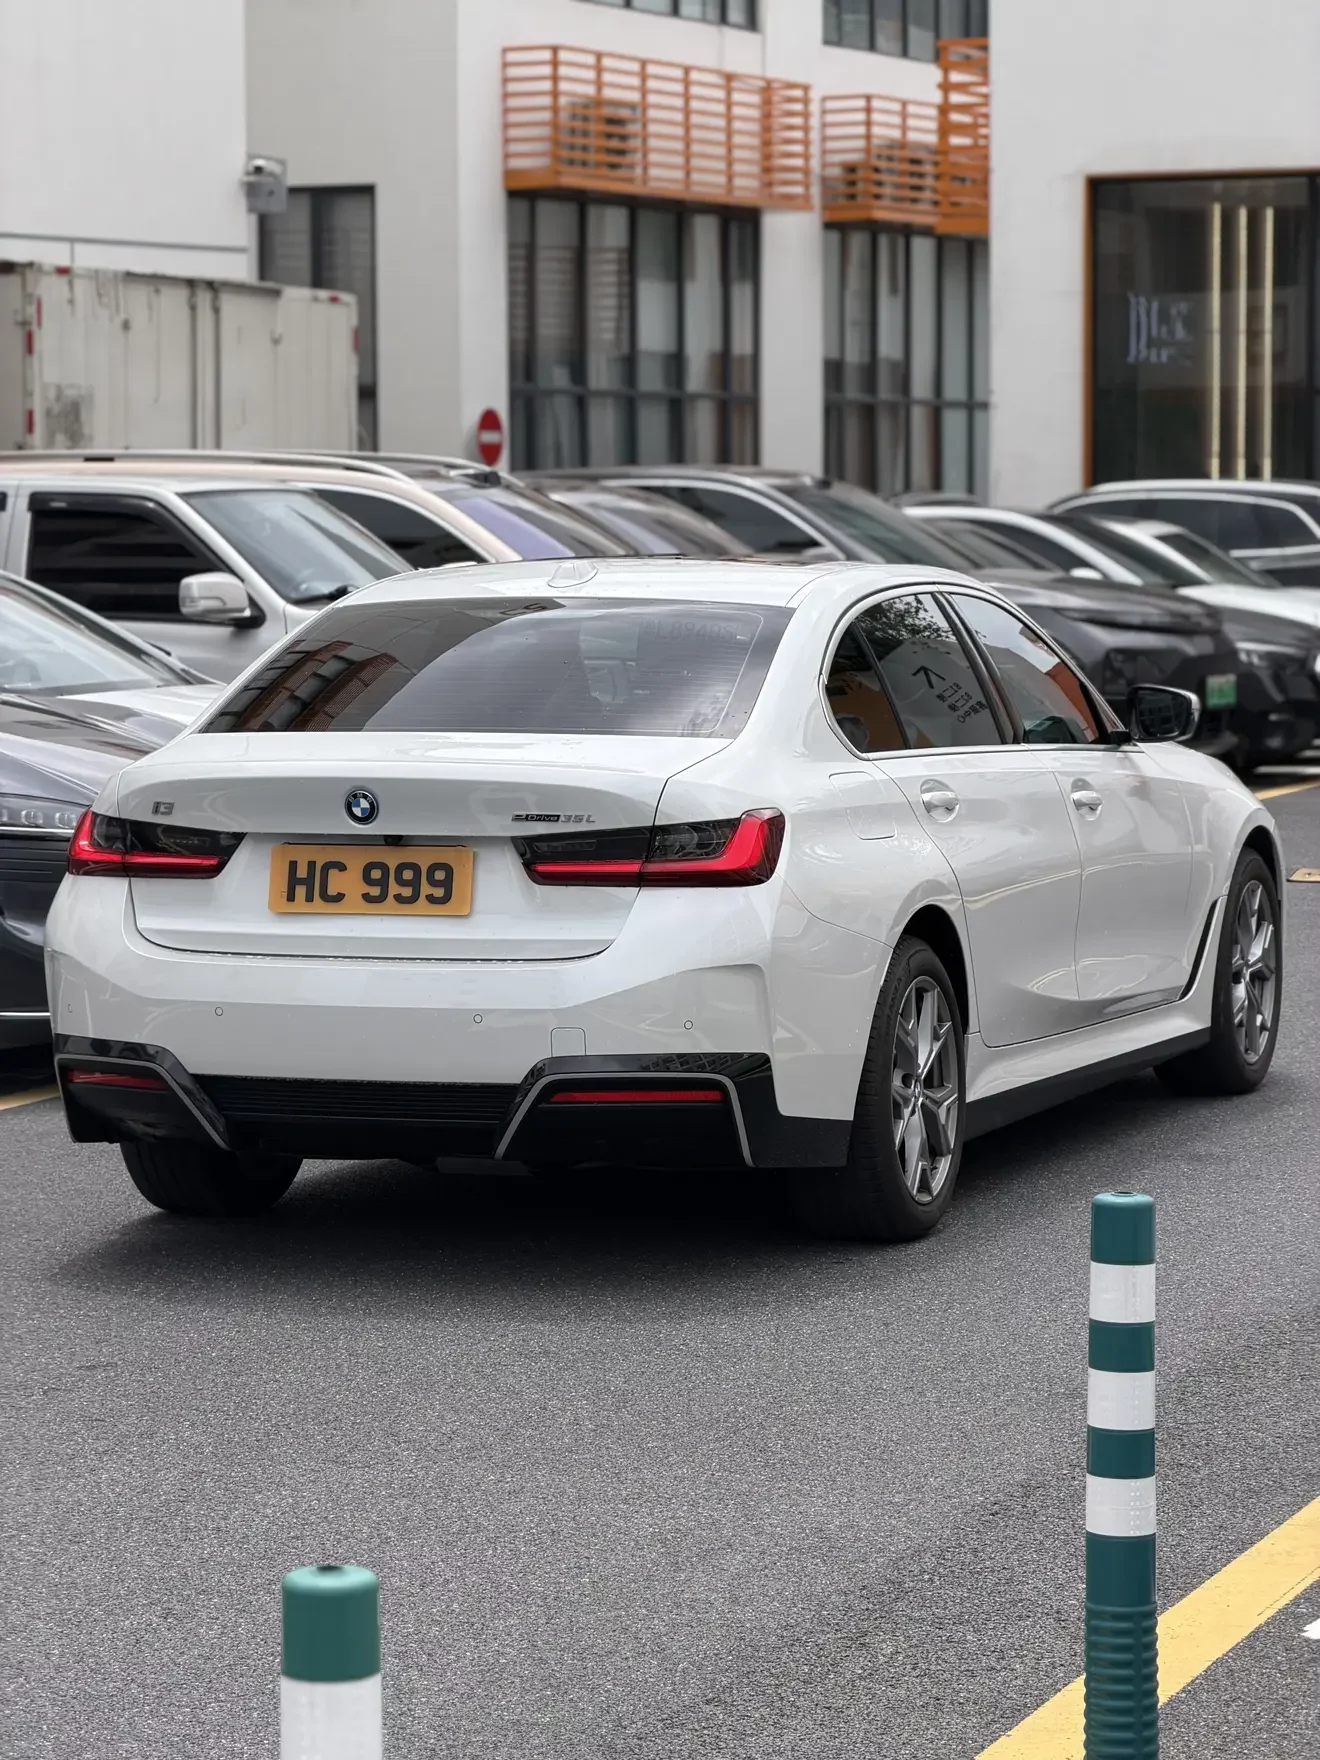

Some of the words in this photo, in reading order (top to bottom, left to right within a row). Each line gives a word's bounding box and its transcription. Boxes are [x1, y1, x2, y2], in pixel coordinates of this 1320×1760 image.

[151, 801, 175, 816] i3
[286, 860, 348, 904] HC
[361, 861, 455, 905] 999
